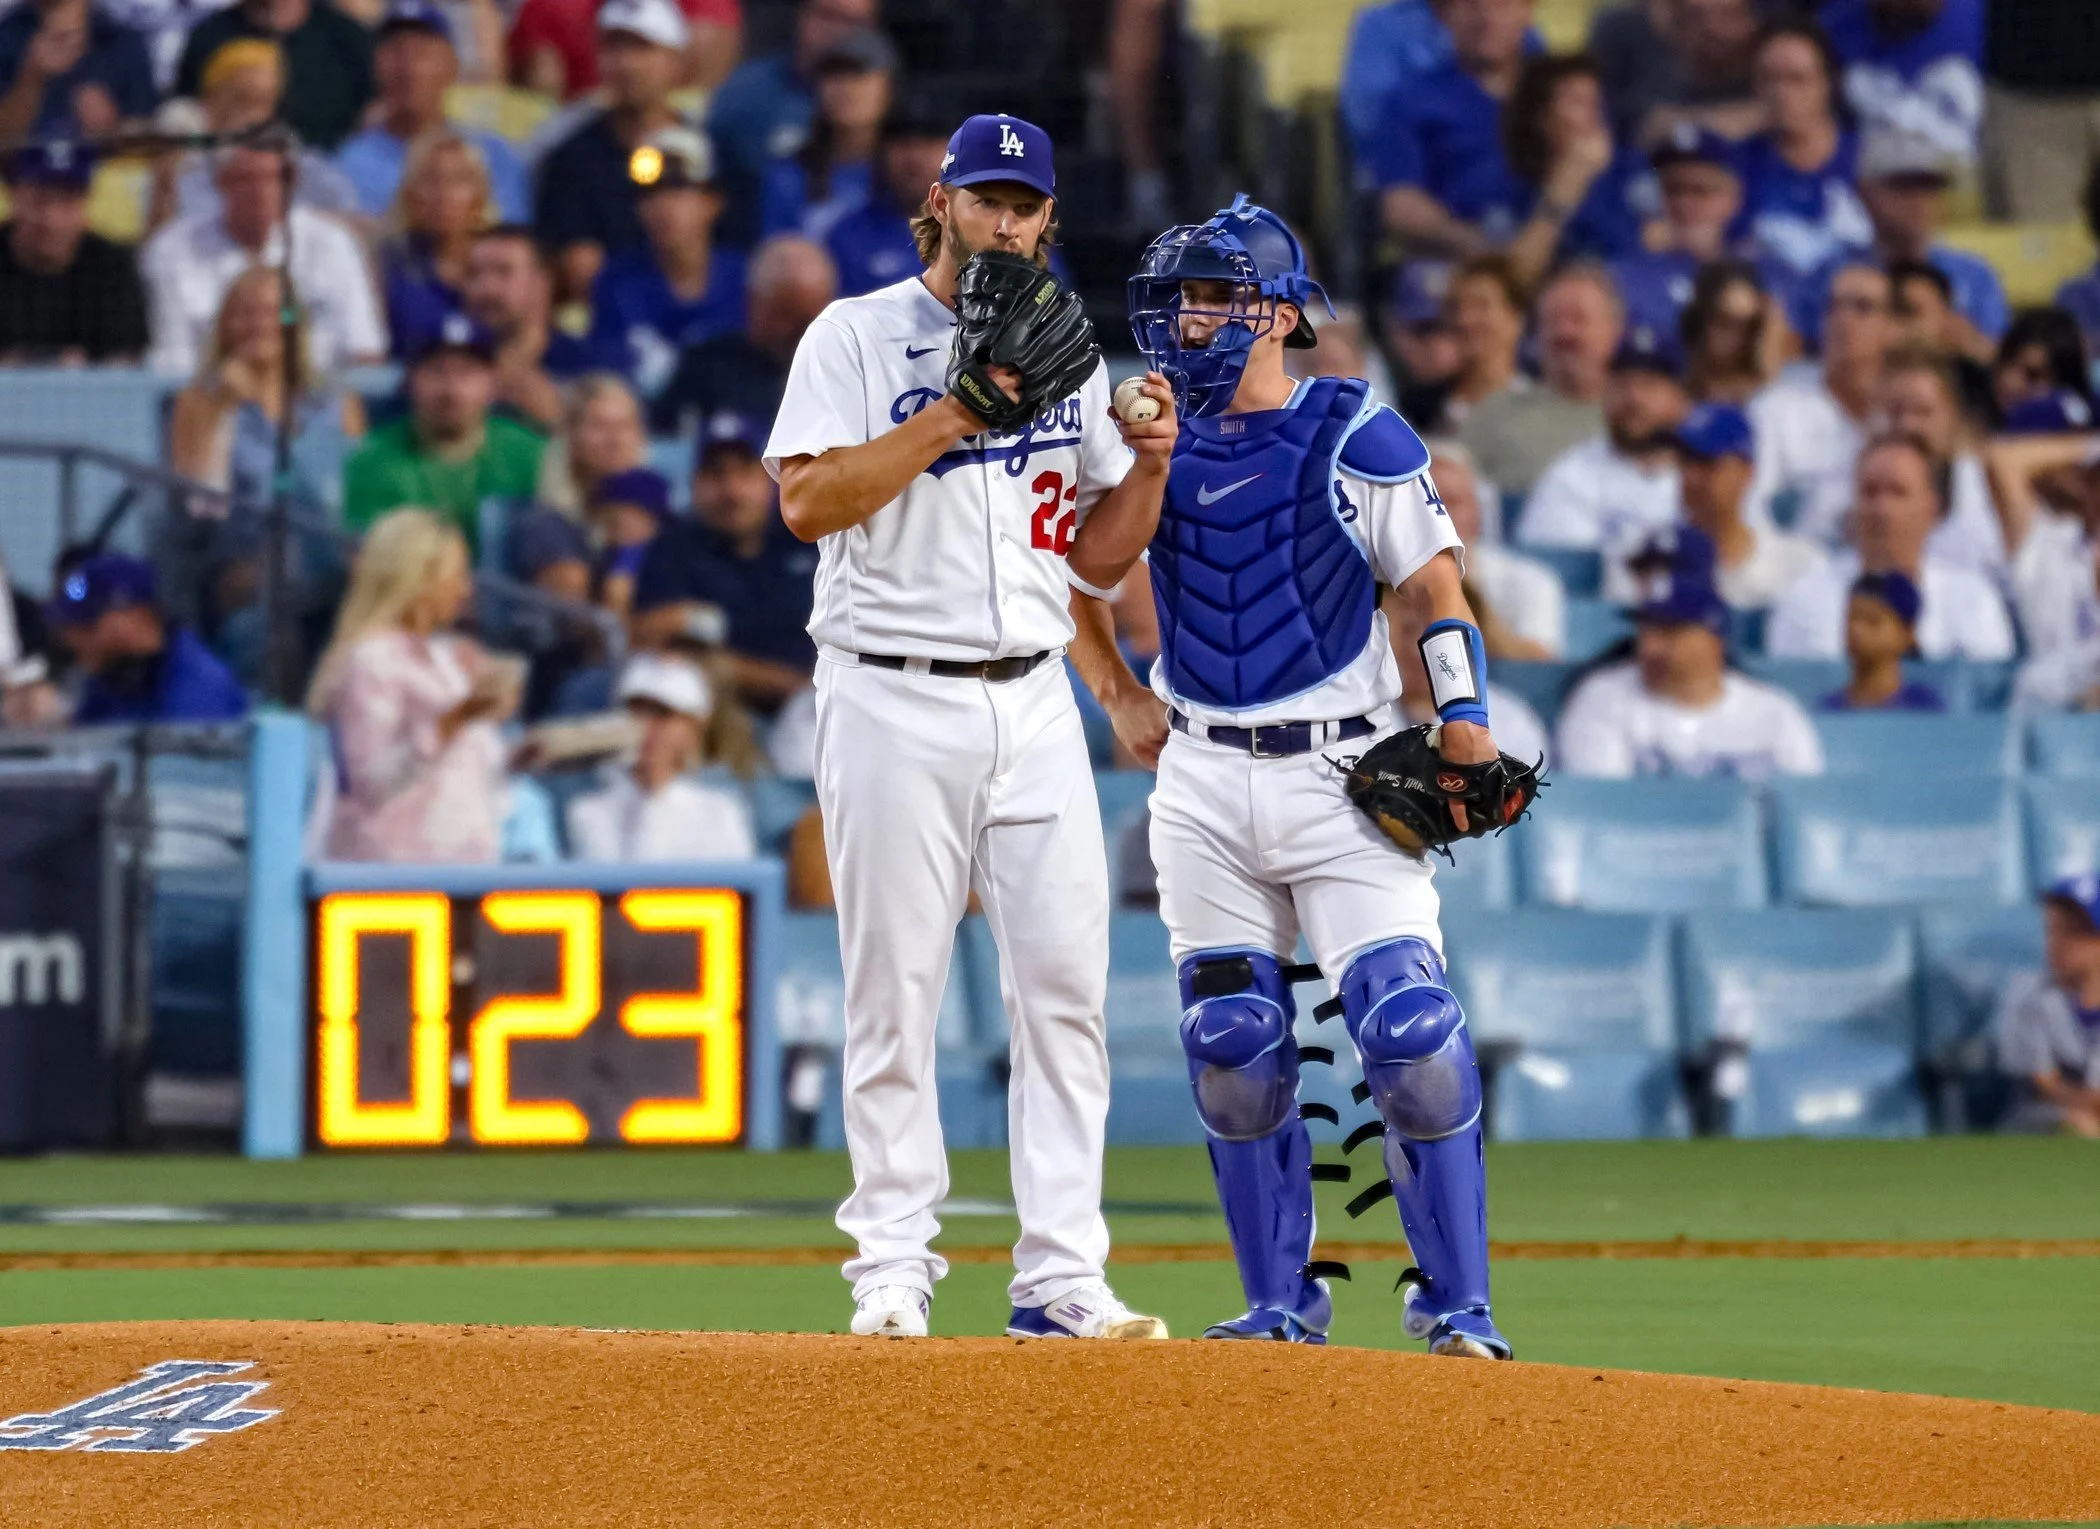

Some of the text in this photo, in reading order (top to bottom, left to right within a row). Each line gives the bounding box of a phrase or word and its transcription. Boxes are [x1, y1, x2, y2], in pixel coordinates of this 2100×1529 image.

[999, 124, 1025, 158] LA
[959, 373, 994, 409] Wilson
[890, 386, 1083, 478] Dgers
[1220, 420, 1246, 435] SMITH
[0, 1360, 284, 1453] LA
